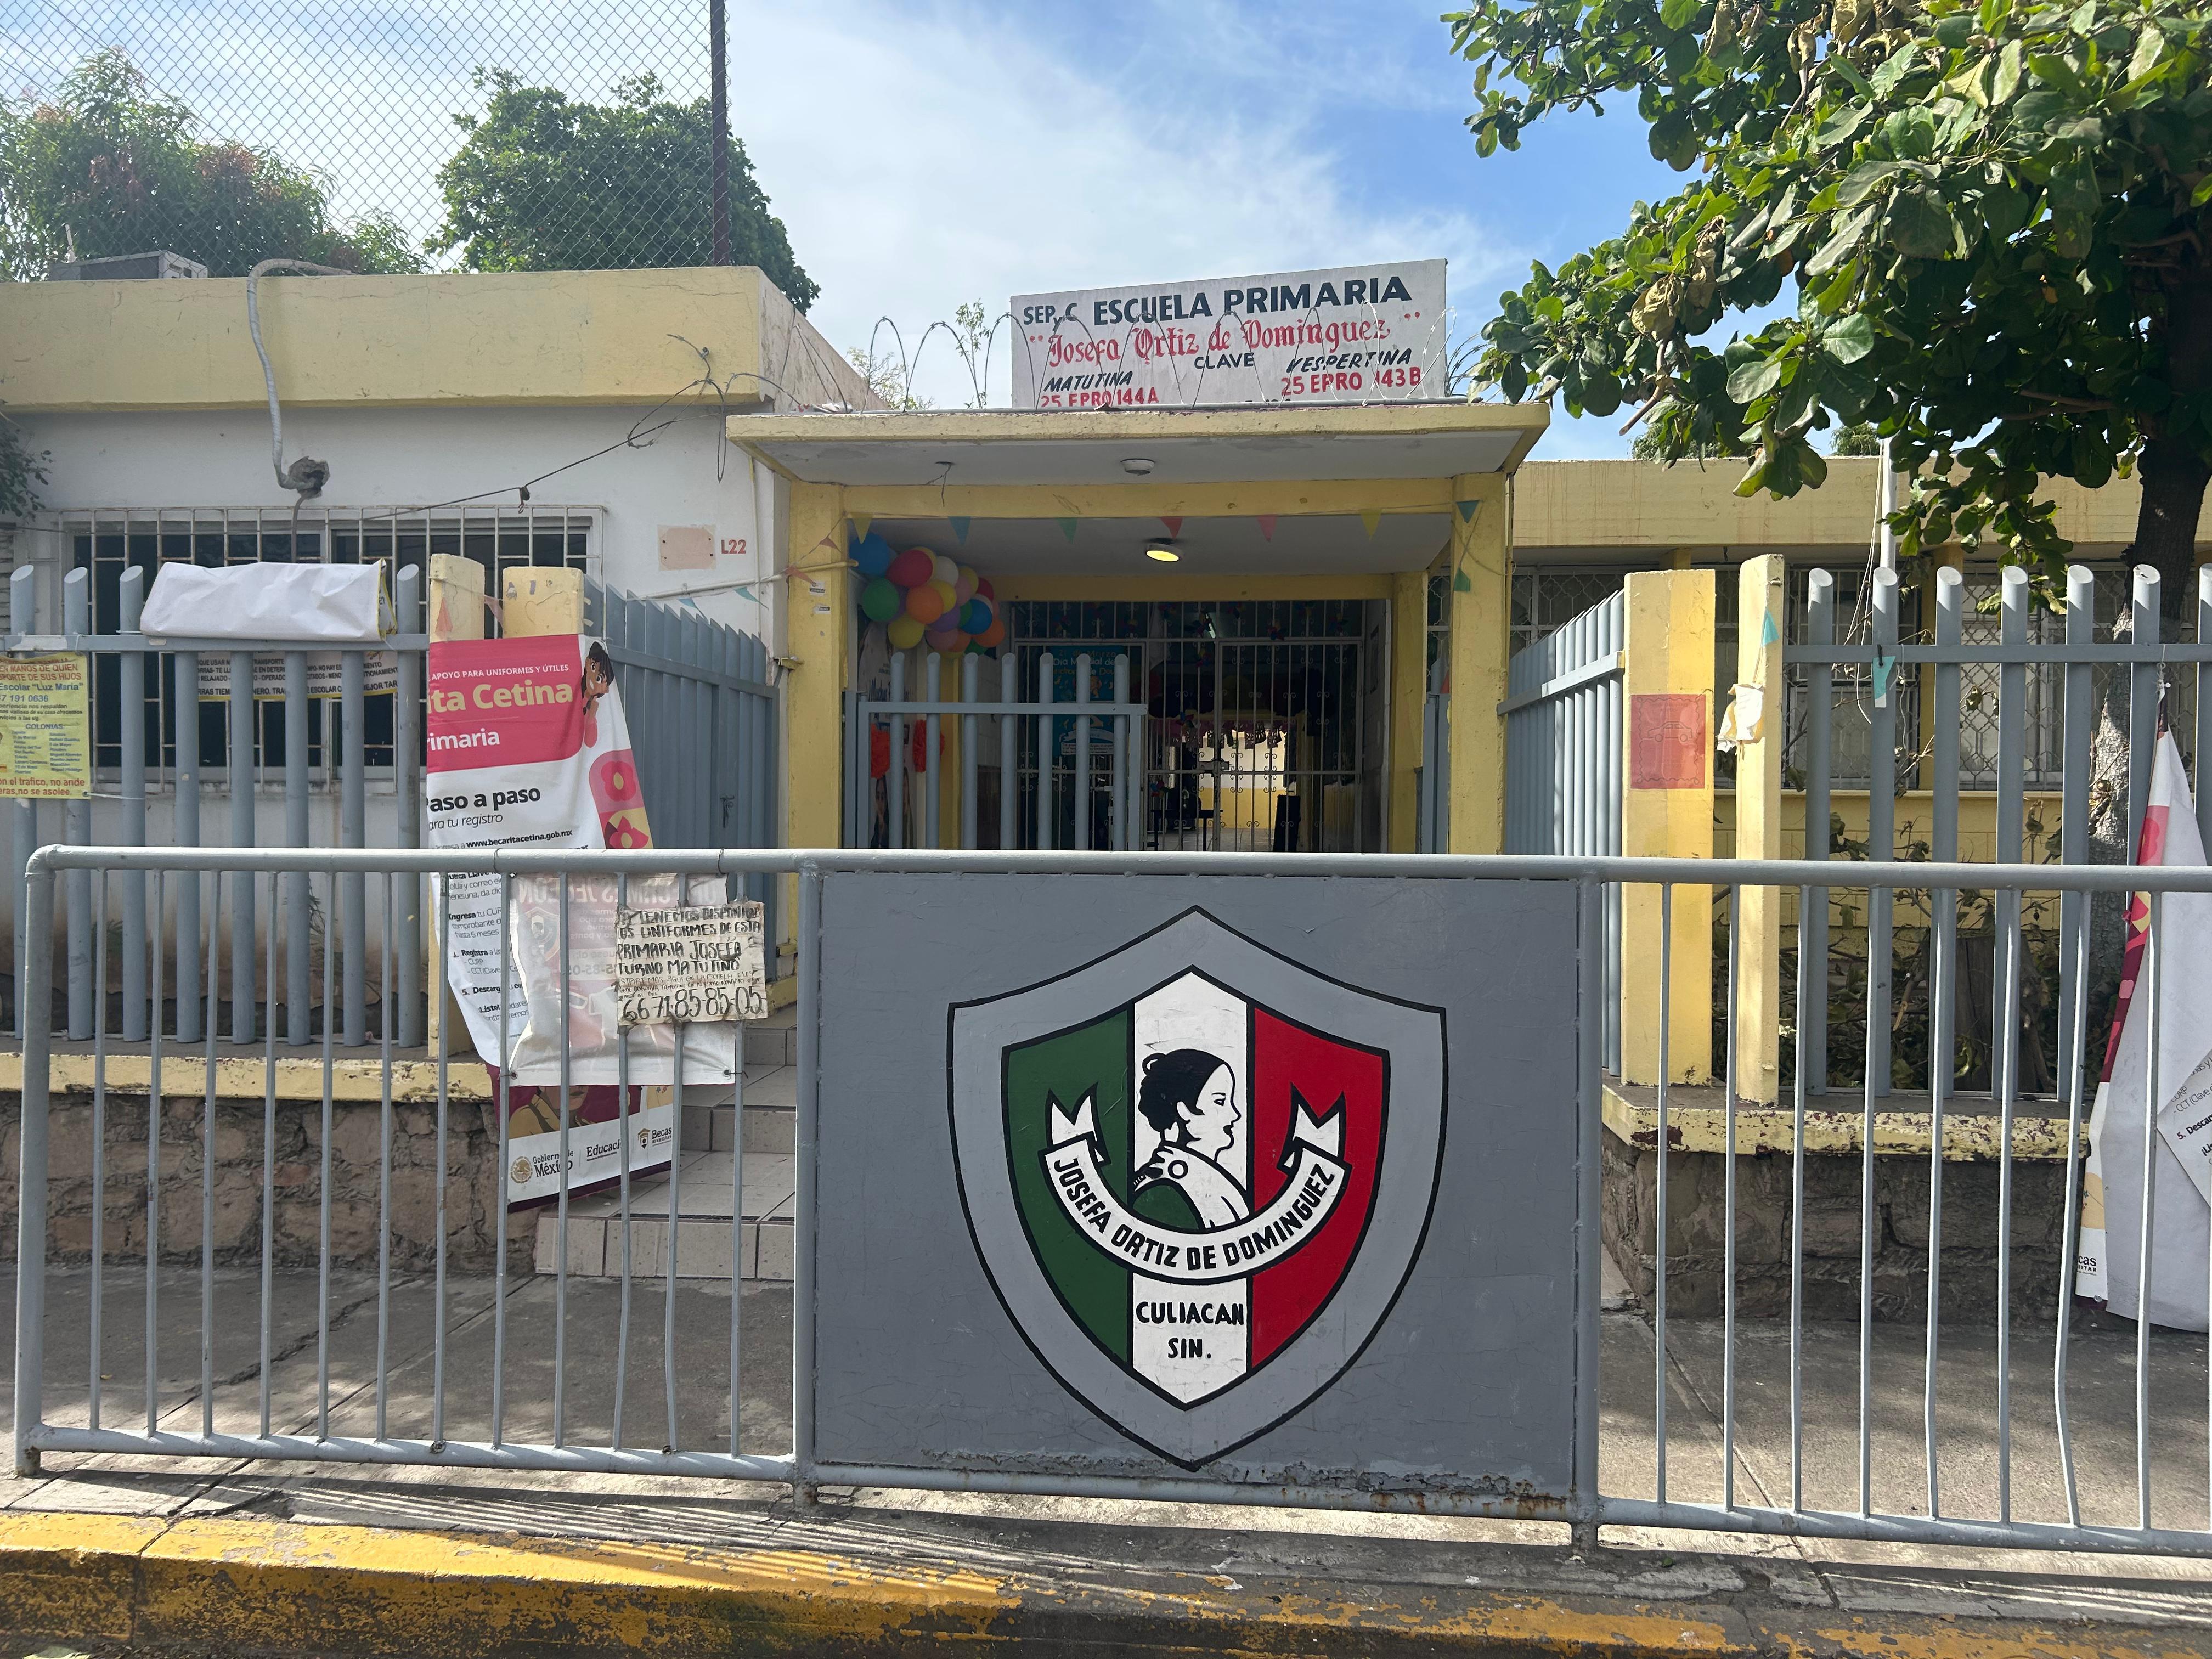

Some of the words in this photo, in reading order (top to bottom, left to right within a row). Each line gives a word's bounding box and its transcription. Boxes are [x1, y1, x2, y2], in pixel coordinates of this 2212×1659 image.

[1094, 292, 1212, 325] ESCUELA
[1224, 276, 1413, 315] PRIMARIA
[1131, 326, 1199, 365] Ortiz
[1208, 323, 1231, 351] de
[1194, 352, 1254, 369] CLAVE
[1286, 348, 1412, 373] VESPERTINA
[1043, 371, 1133, 392] MATUTINA
[1281, 376, 1305, 396] 25
[1311, 371, 1362, 394] EPRO
[721, 539, 746, 554] L22
[11, 664, 37, 673] MANOS
[53, 663, 78, 672] QUIEN
[59, 672, 81, 680] HIJOS
[432, 670, 460, 681] APOYO
[462, 669, 484, 678] PARA
[486, 666, 534, 676] UNIFORMES
[543, 664, 569, 673] ÚTILES
[473, 679, 573, 709] Cetina
[9, 777, 16, 786] el
[64, 777, 84, 786] ande
[427, 795, 469, 812] aso
[473, 793, 487, 808] a
[492, 788, 541, 811] paso
[448, 817, 459, 828] tu
[462, 813, 503, 828] registro
[466, 829, 573, 849] www.becaritacetina.gob.mx
[470, 879, 493, 888] correo
[449, 912, 476, 922] Ingresa
[476, 928, 500, 938] meses
[640, 923, 718, 939] UNIFORMES
[719, 922, 732, 935] DE
[734, 920, 762, 934] ESTA
[461, 949, 488, 957] Registra
[616, 941, 684, 960] PRIMARIA
[618, 961, 663, 977] TURNO
[667, 958, 741, 976] MATUTINO
[2176, 1098, 2191, 1113] CCT
[652, 1127, 672, 1139] Becas
[2176, 1131, 2187, 1141] 5.
[533, 1153, 561, 1164] Gobiern
[1054, 1157, 1114, 1234] JOSEFA
[1111, 1224, 1179, 1268] ORTIZ
[1186, 1245, 1216, 1271] DE
[1222, 1163, 1336, 1268] DOMINGUEZ
[1136, 1301, 1245, 1325] CULIACAN
[1167, 1337, 1212, 1359] SIN.
